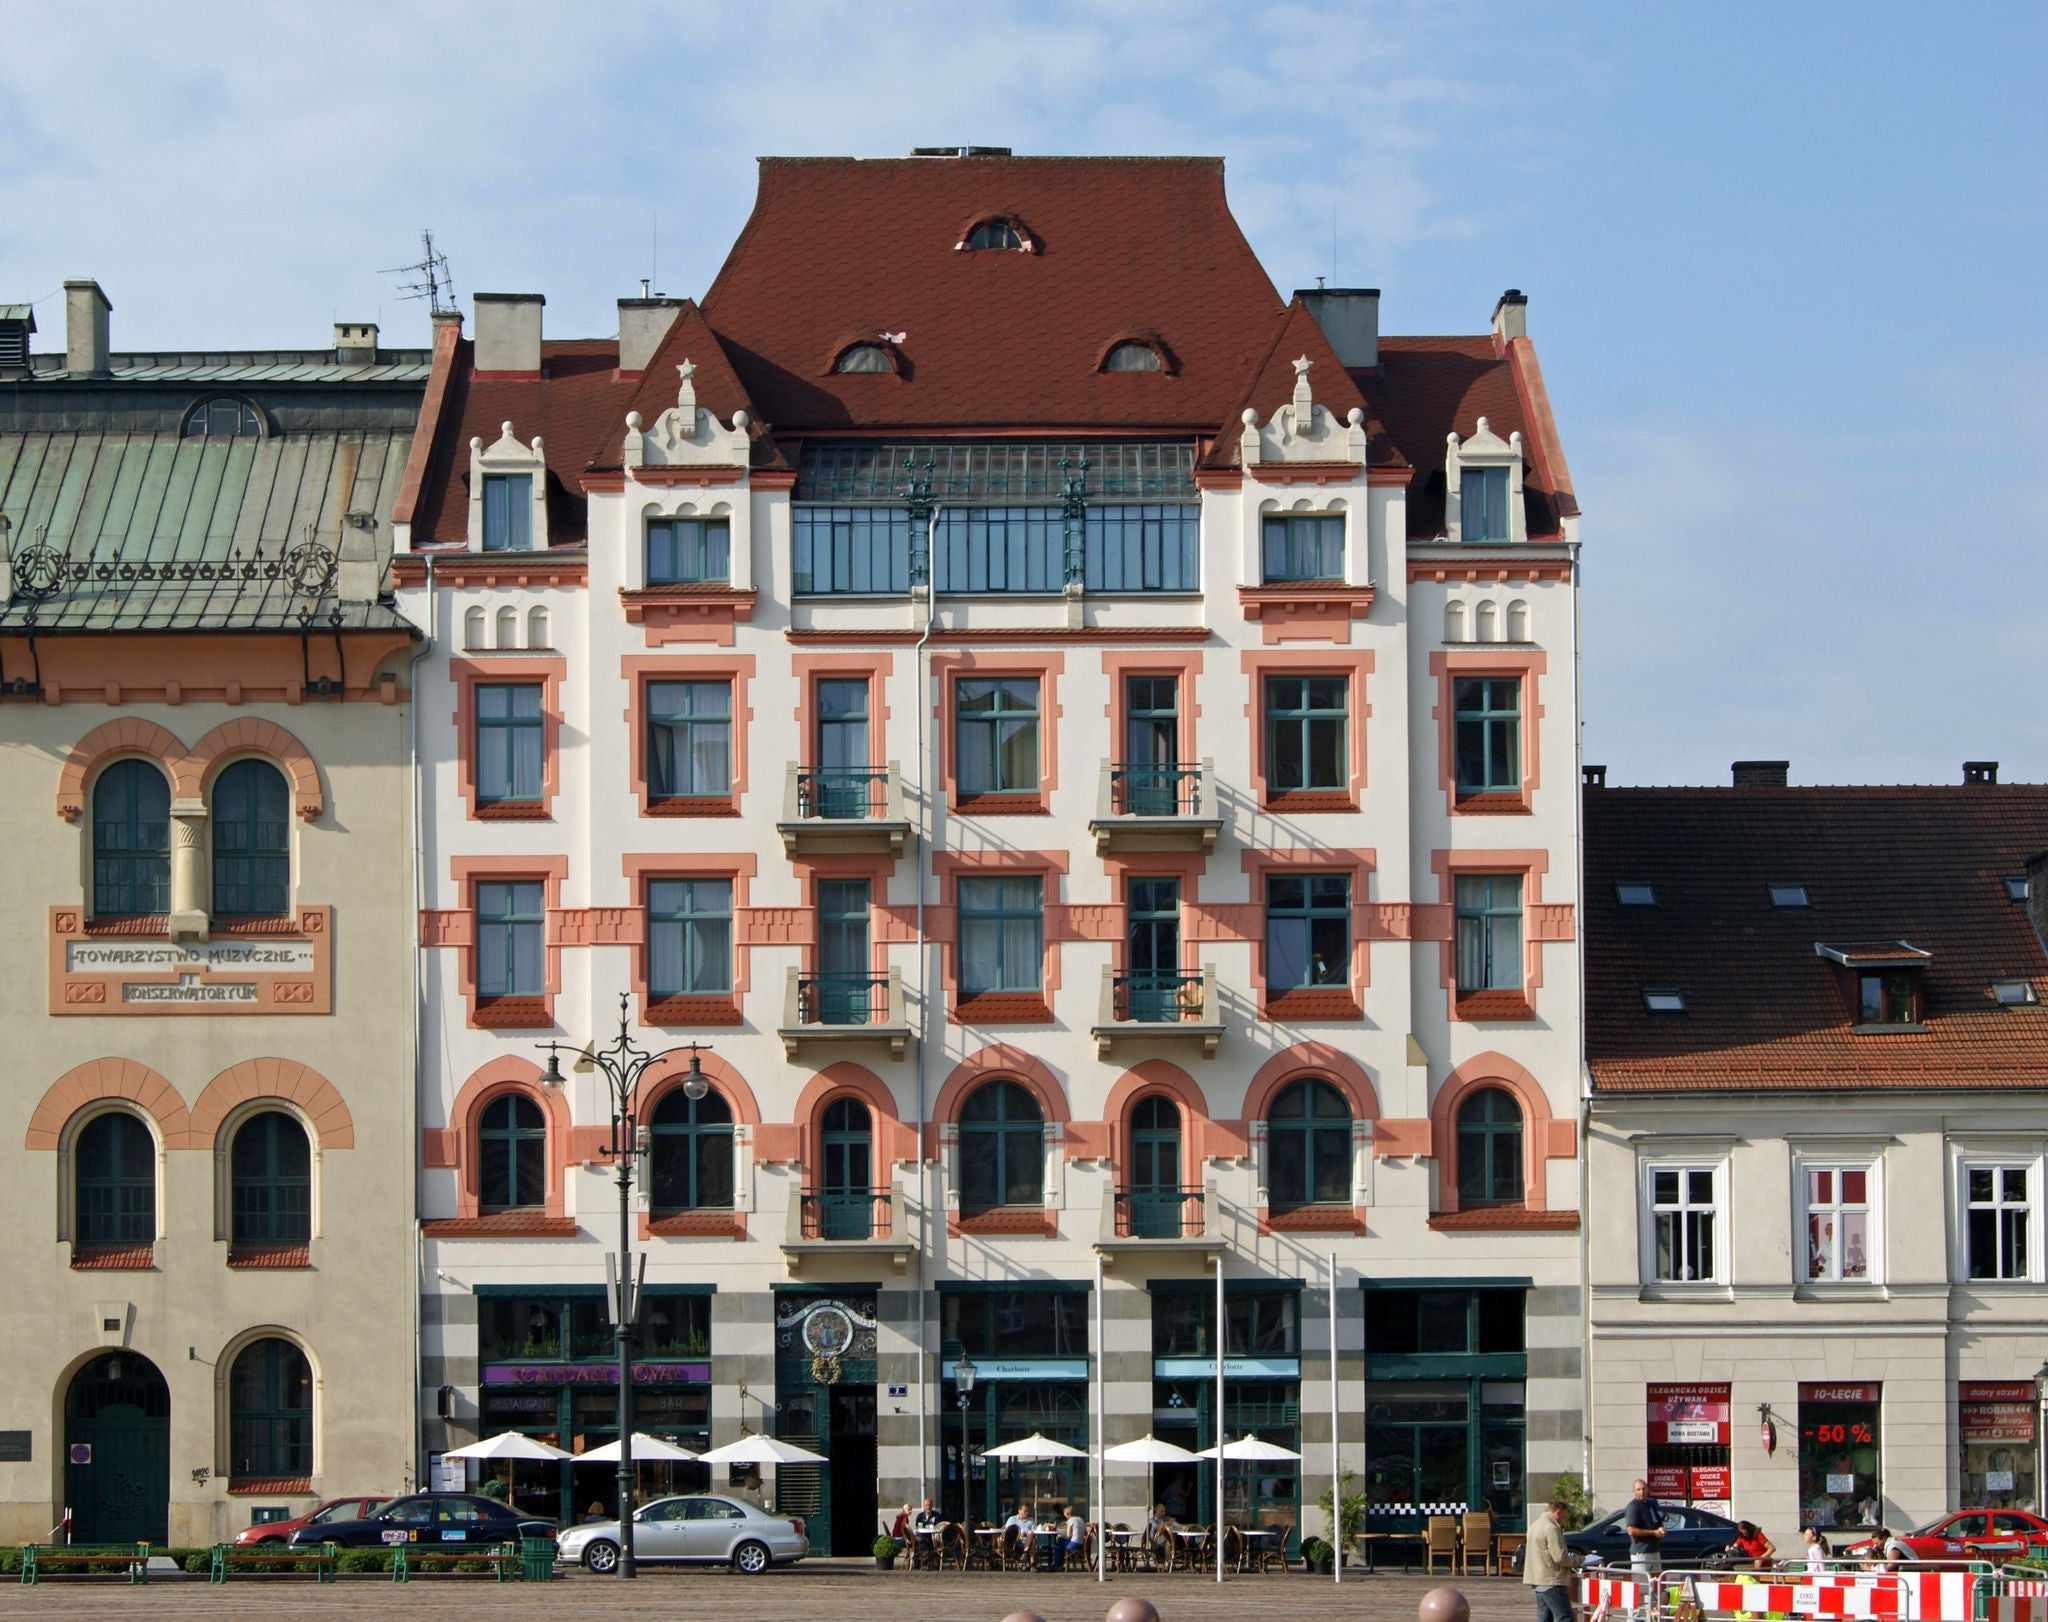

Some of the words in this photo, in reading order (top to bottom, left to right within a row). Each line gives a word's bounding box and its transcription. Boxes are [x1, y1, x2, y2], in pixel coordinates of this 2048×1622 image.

[76, 950, 200, 963] TOWARZYSTWO
[208, 949, 296, 964] MUZYCZNE
[509, 1365, 609, 1383] SCANDALE
[626, 1363, 685, 1382] OYAL
[996, 1365, 1032, 1373] Charlotte
[1814, 1389, 1864, 1400] 10-LECIE
[1970, 1389, 1995, 1398] dobry
[1668, 1395, 1708, 1403] UŻYWANA
[489, 1399, 552, 1410] RESTAURANT
[659, 1399, 683, 1409] BAR
[1980, 1406, 2015, 1415] ROBAN
